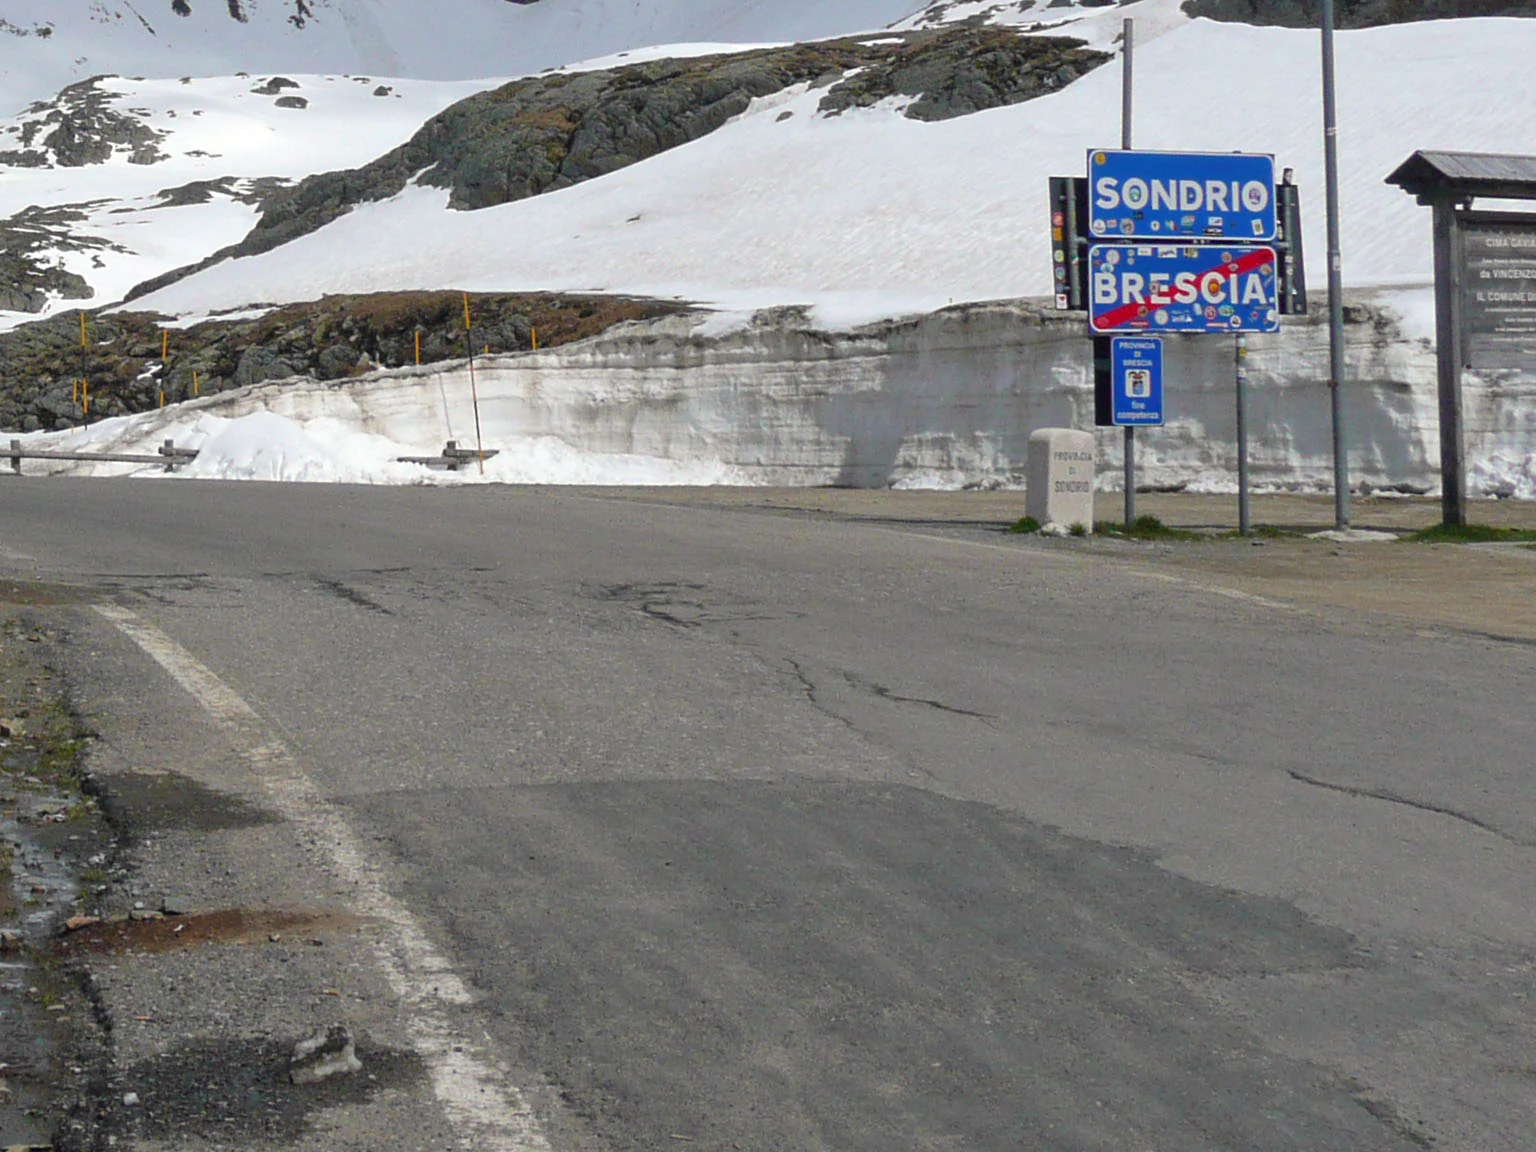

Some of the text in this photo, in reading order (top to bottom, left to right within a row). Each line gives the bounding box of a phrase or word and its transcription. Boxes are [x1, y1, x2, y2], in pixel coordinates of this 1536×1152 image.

[1095, 176, 1268, 213] SONDRIO
[1094, 271, 1267, 305] BRESCIA
[1119, 342, 1156, 350] PROVINCIA
[1123, 359, 1153, 367] BRESCIA
[1054, 451, 1093, 461] PROVINCIA
